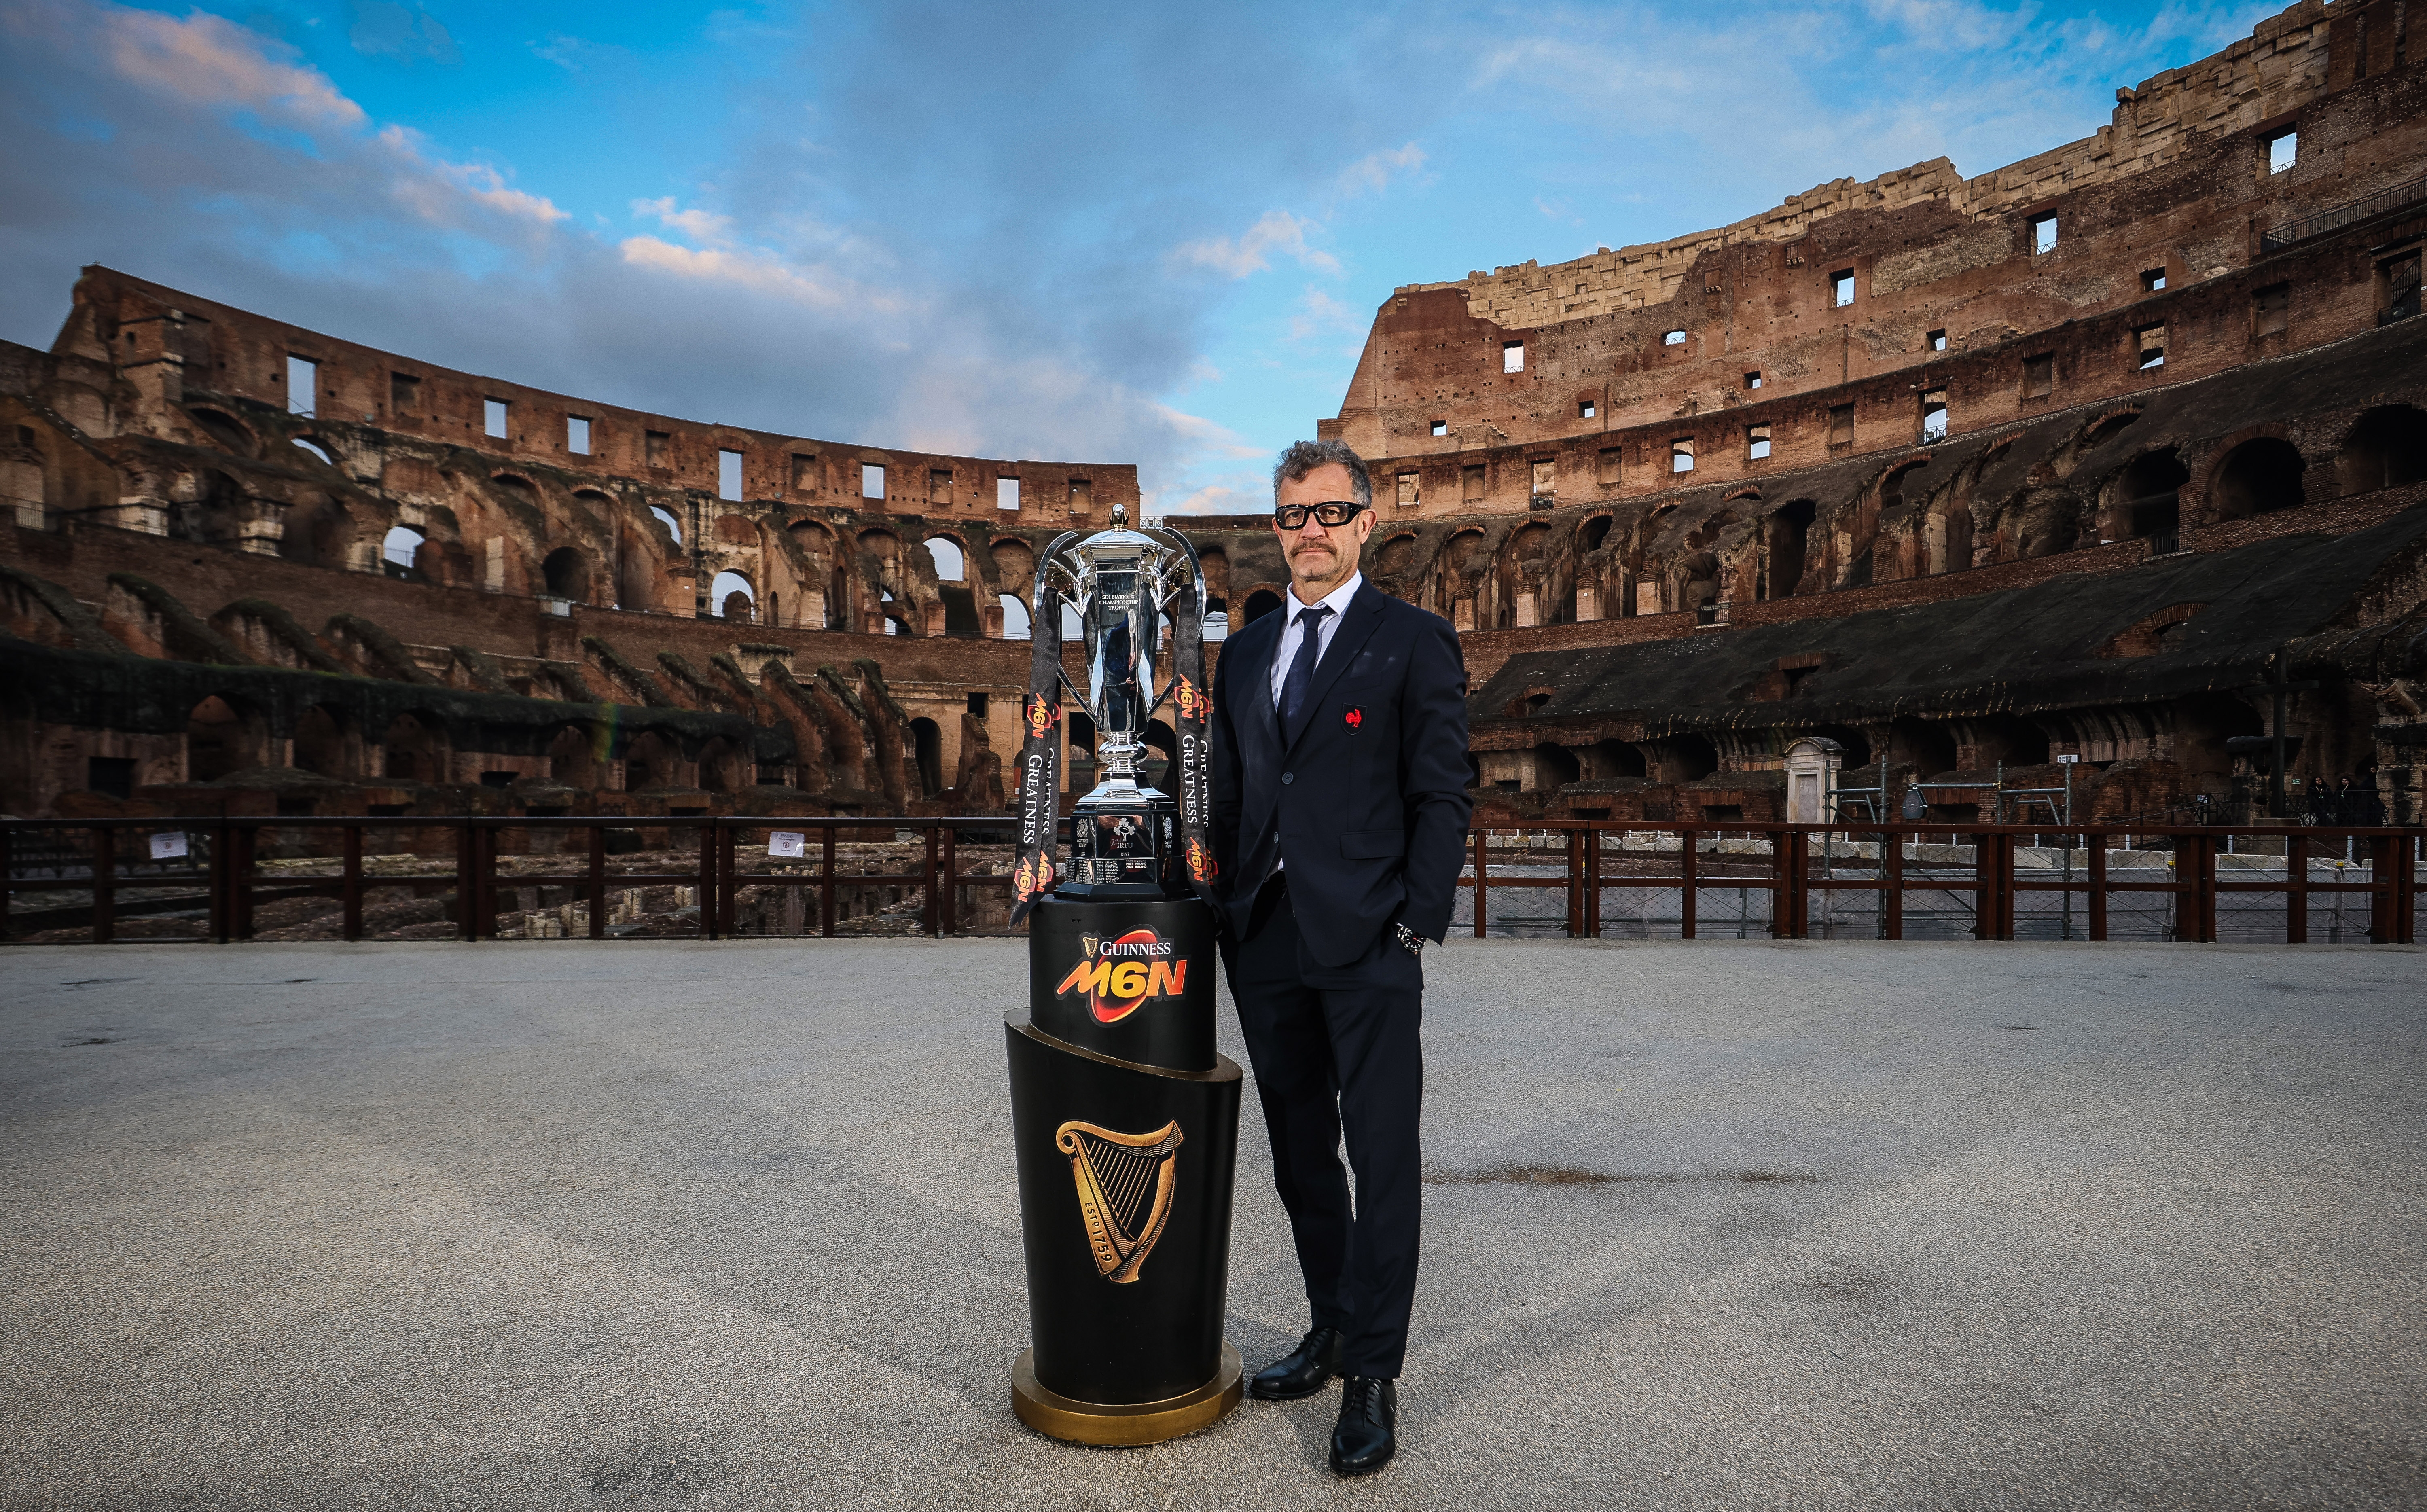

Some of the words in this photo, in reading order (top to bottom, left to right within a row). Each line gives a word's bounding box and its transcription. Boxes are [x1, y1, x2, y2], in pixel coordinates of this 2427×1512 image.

[1032, 692, 1046, 739] M6N
[1180, 673, 1193, 718] M6N
[1023, 754, 1042, 843] GREATNESS
[1182, 735, 1197, 824] GREATNESS
[1018, 856, 1032, 902] M6N
[1190, 836, 1203, 881] M6N
[1100, 941, 1171, 956] GUINNESS
[1057, 960, 1187, 998] M6N
[1092, 1230, 1112, 1262] 1759
